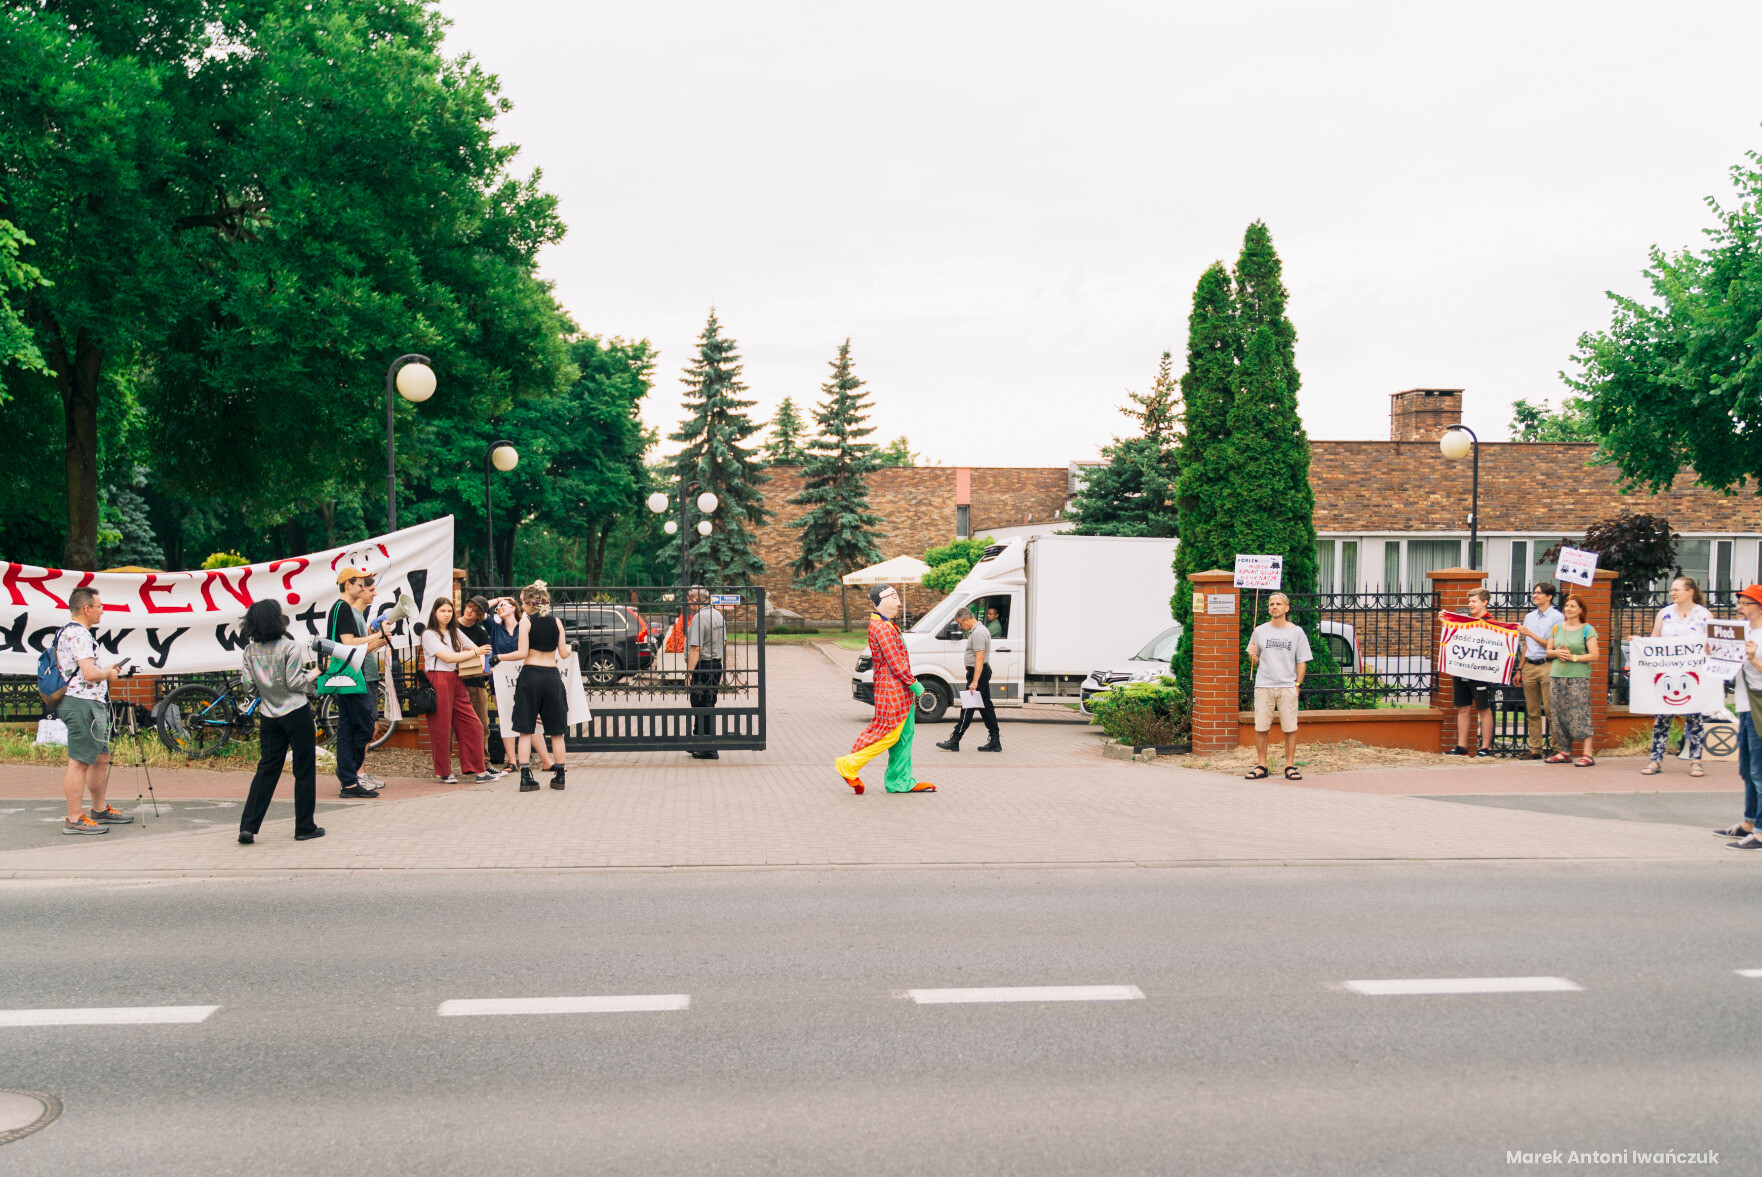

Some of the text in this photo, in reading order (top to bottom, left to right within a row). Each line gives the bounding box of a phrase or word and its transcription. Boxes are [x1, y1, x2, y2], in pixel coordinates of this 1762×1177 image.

[1452, 633, 1503, 647] dość robienia
[1452, 645, 1499, 661] cyrku
[1643, 643, 1704, 657] ORLEN?
[1453, 660, 1500, 673] transformacji
